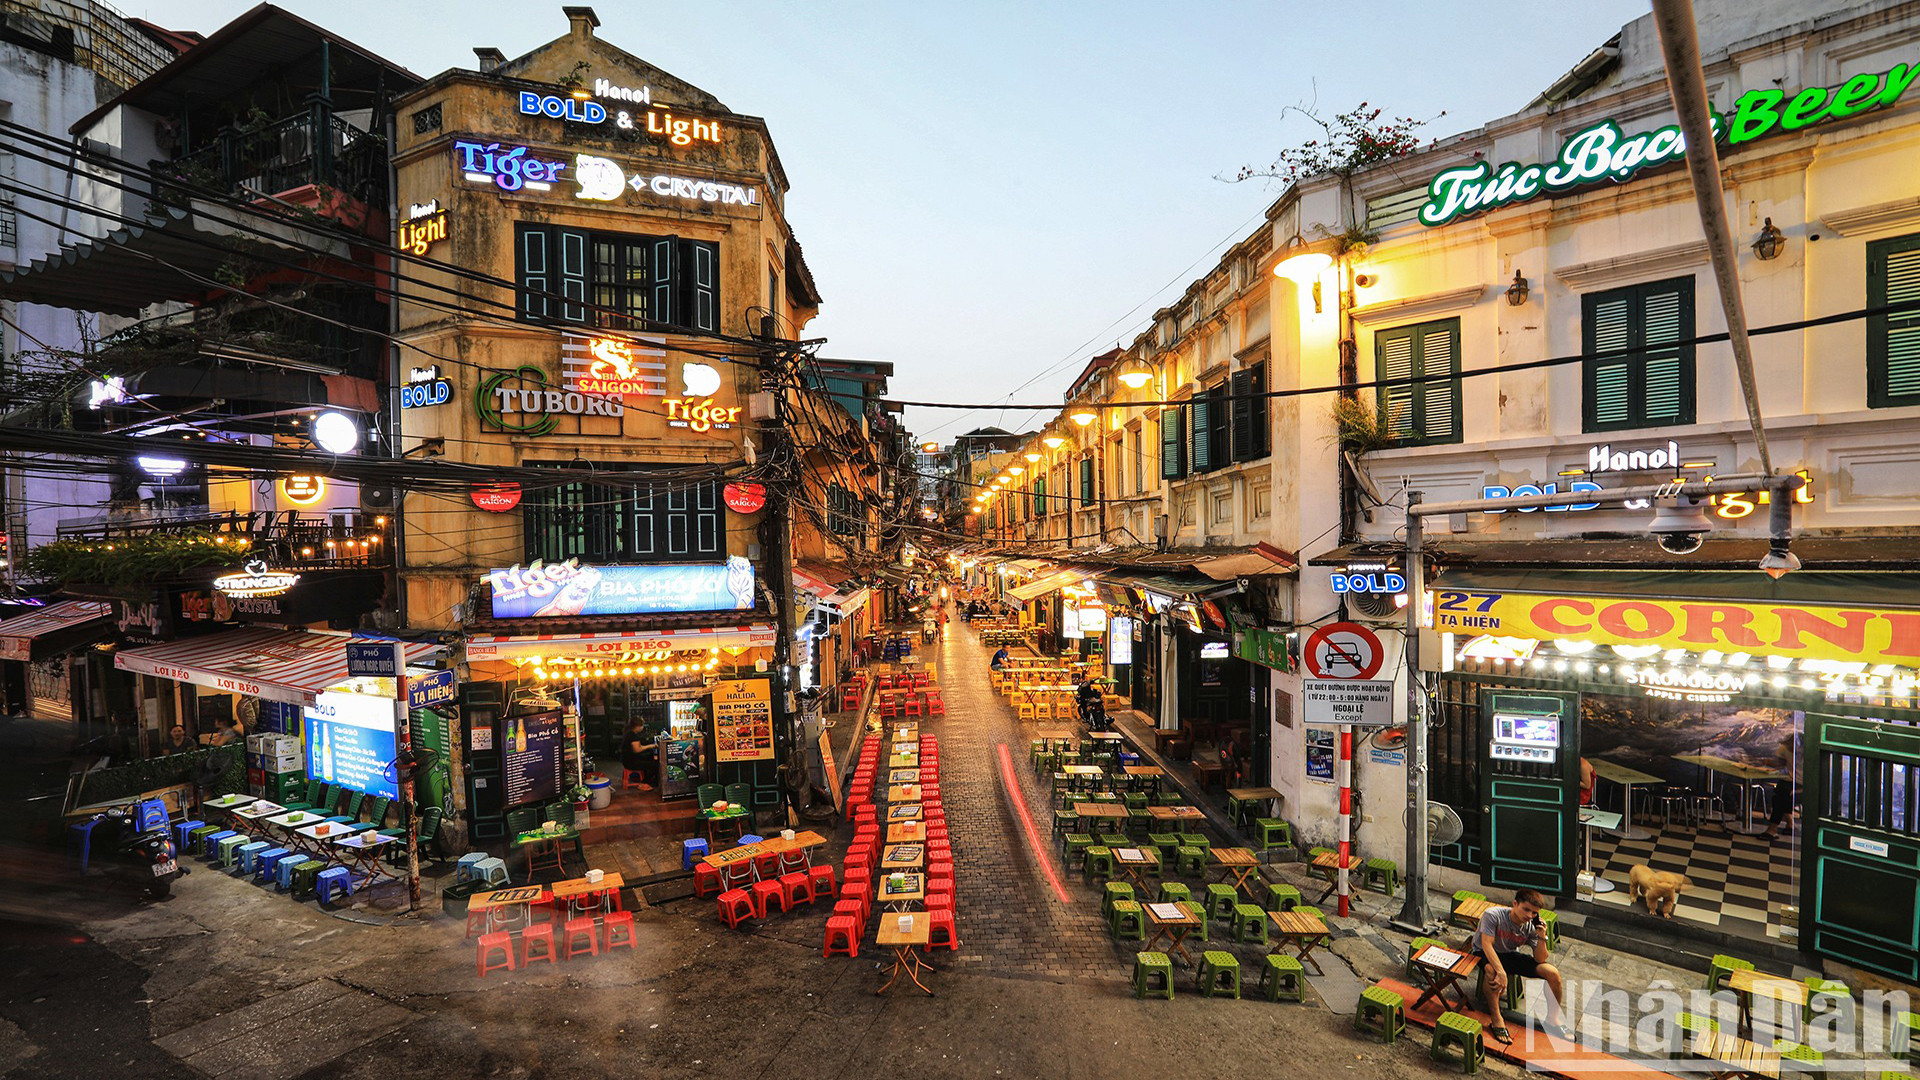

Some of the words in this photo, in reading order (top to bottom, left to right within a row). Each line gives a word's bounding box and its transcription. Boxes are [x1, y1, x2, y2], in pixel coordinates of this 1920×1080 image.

[594, 78, 651, 105] Hanoi
[518, 91, 607, 125] BOLD
[616, 111, 634, 129] &
[646, 111, 721, 146] Light
[1422, 161, 1542, 225] Trúc
[1547, 117, 1720, 185] Bạc
[1730, 63, 1920, 143] Beer
[454, 141, 566, 192] Tiger
[650, 176, 763, 207] CRYSTAL
[400, 214, 447, 256] Light
[602, 373, 621, 381] BIA
[401, 381, 450, 409] BOLD
[579, 380, 645, 394] SAIGON
[495, 387, 625, 417] TUBORG
[661, 397, 743, 432] Tiger
[1587, 438, 1680, 474] Hanoi
[1482, 481, 1604, 515] BOLD
[213, 575, 301, 590] STRONGBOW
[480, 557, 582, 597] Tiger
[1330, 573, 1406, 593] BOLD
[600, 580, 637, 596] BIA
[237, 599, 281, 615] CRYSTAL
[1439, 592, 1502, 612] 27
[1439, 614, 1462, 631] TẠ
[1463, 613, 1501, 630] HIỆN
[363, 648, 379, 657] PHỐ
[629, 638, 672, 651] BÉO
[171, 666, 190, 680] BÉO
[423, 675, 439, 687] PHỐ
[1626, 670, 1746, 692] STRONGBOW
[238, 679, 260, 695] BÉO
[413, 692, 425, 705] TẠ
[427, 685, 450, 701] HIỆN
[1314, 683, 1327, 691] QUÉT
[726, 692, 756, 700] HALIDA
[1645, 689, 1683, 701] APPLE
[1686, 692, 1731, 703] CIDERS
[314, 704, 336, 716] BOLD
[733, 701, 751, 709] PHỐ
[1332, 704, 1355, 714] NGOẠI
[1355, 703, 1364, 714] LỆ
[1334, 713, 1363, 722] Except
